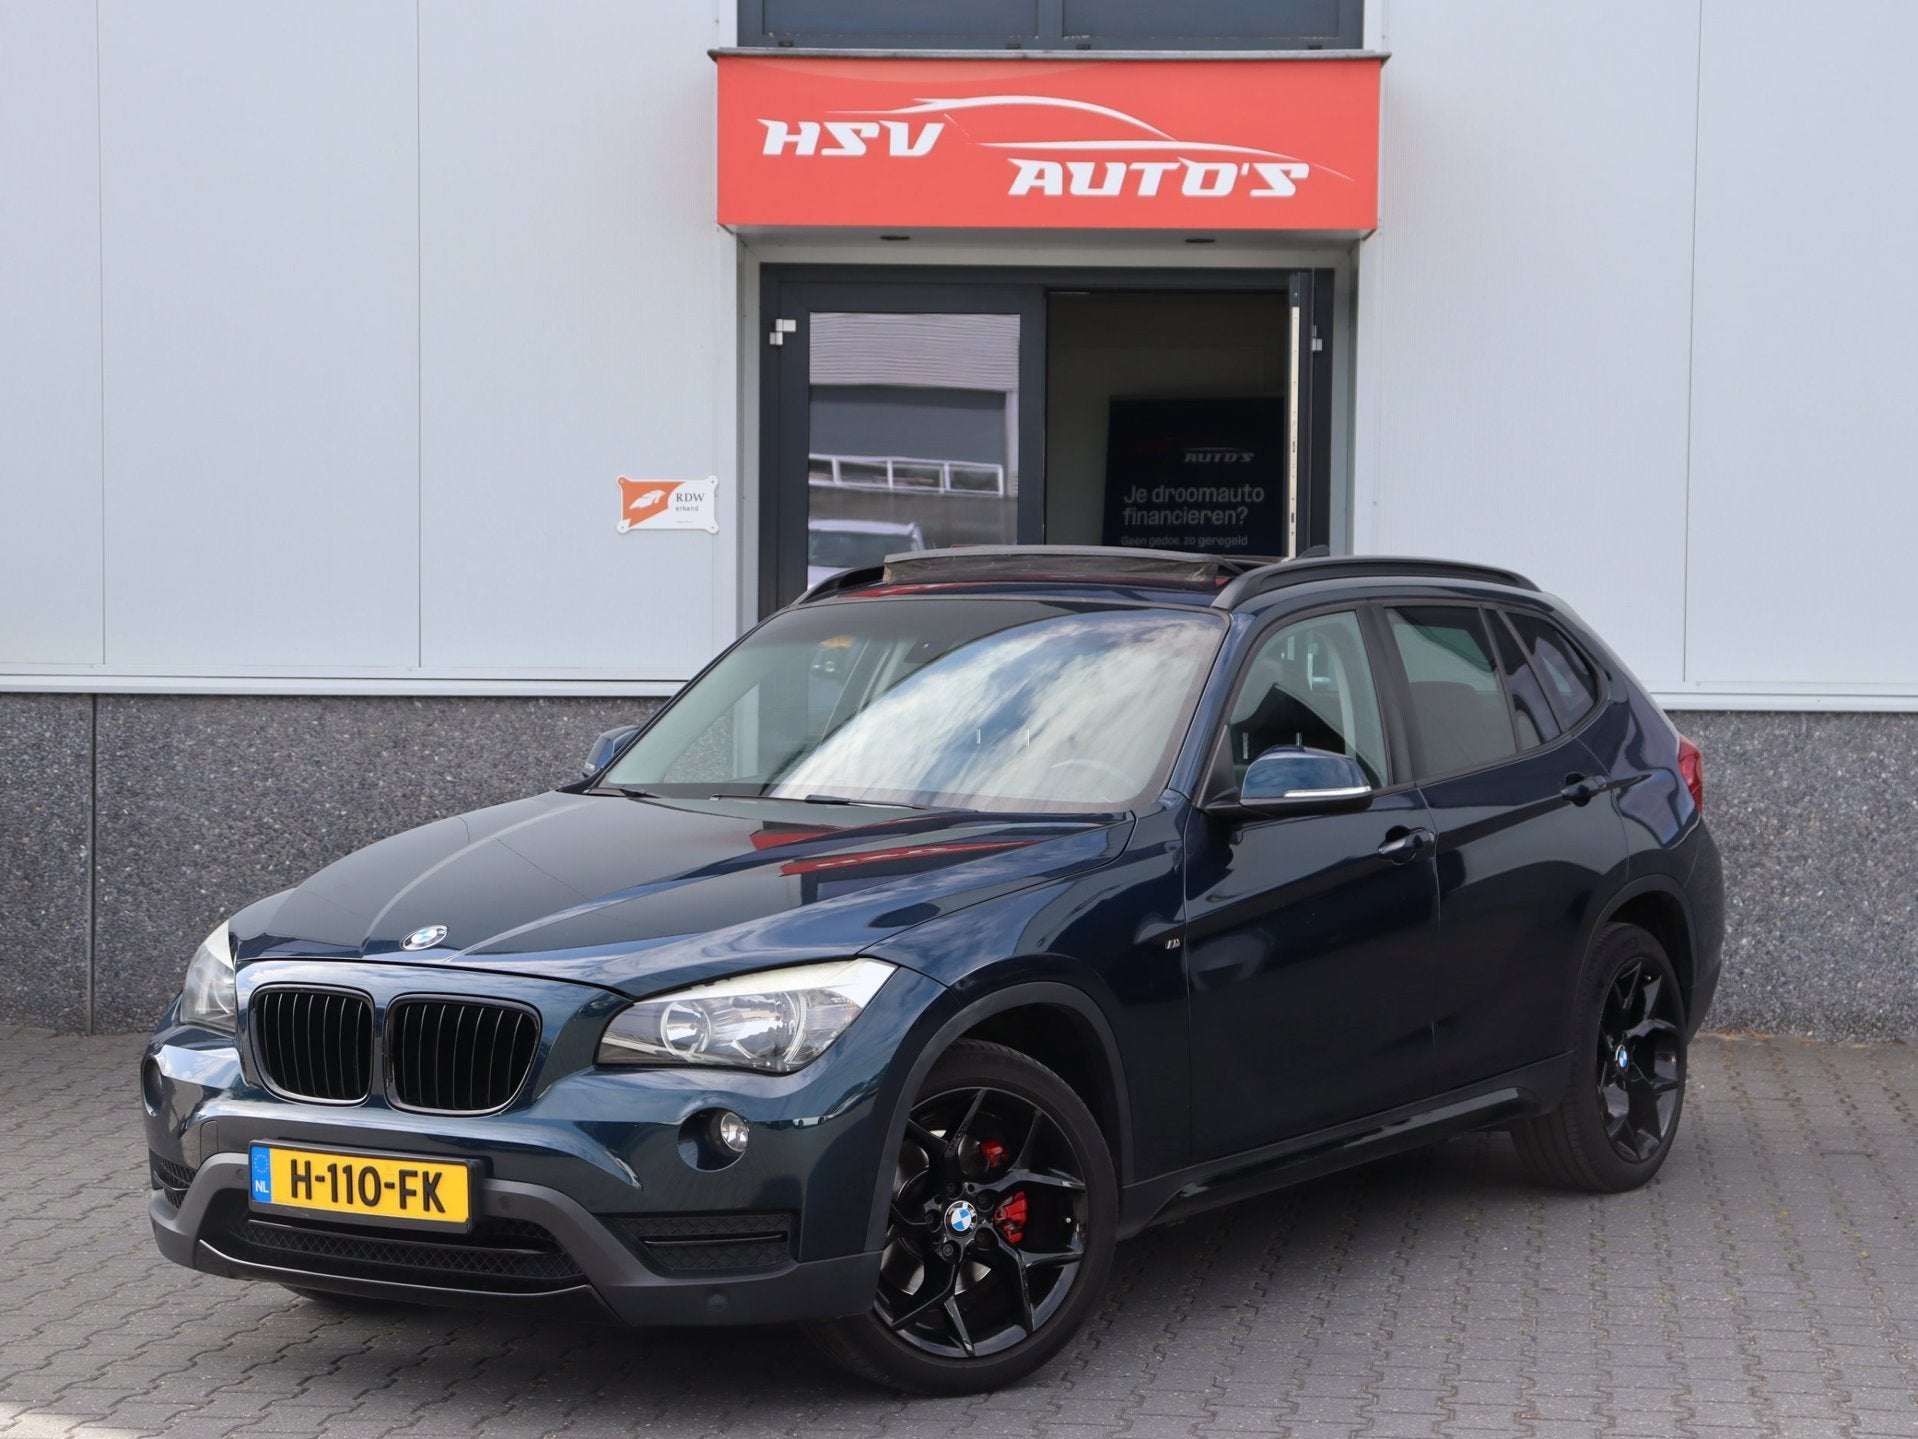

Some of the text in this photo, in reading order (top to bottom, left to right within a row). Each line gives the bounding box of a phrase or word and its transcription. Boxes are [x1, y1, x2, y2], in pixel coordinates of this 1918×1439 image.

[757, 119, 944, 156] HSV
[1007, 157, 1310, 196] AUTO'S
[1184, 452, 1255, 463] AUTO'S
[676, 493, 704, 502] RDW
[1124, 484, 1264, 503] Je droomauto
[1123, 506, 1248, 525] financieren?
[1121, 536, 1147, 546] Geen
[1184, 537, 1195, 545] zo
[1198, 535, 1248, 547] geregeld
[255, 1180, 269, 1193] NL
[290, 1159, 446, 1214] H-110-FK
